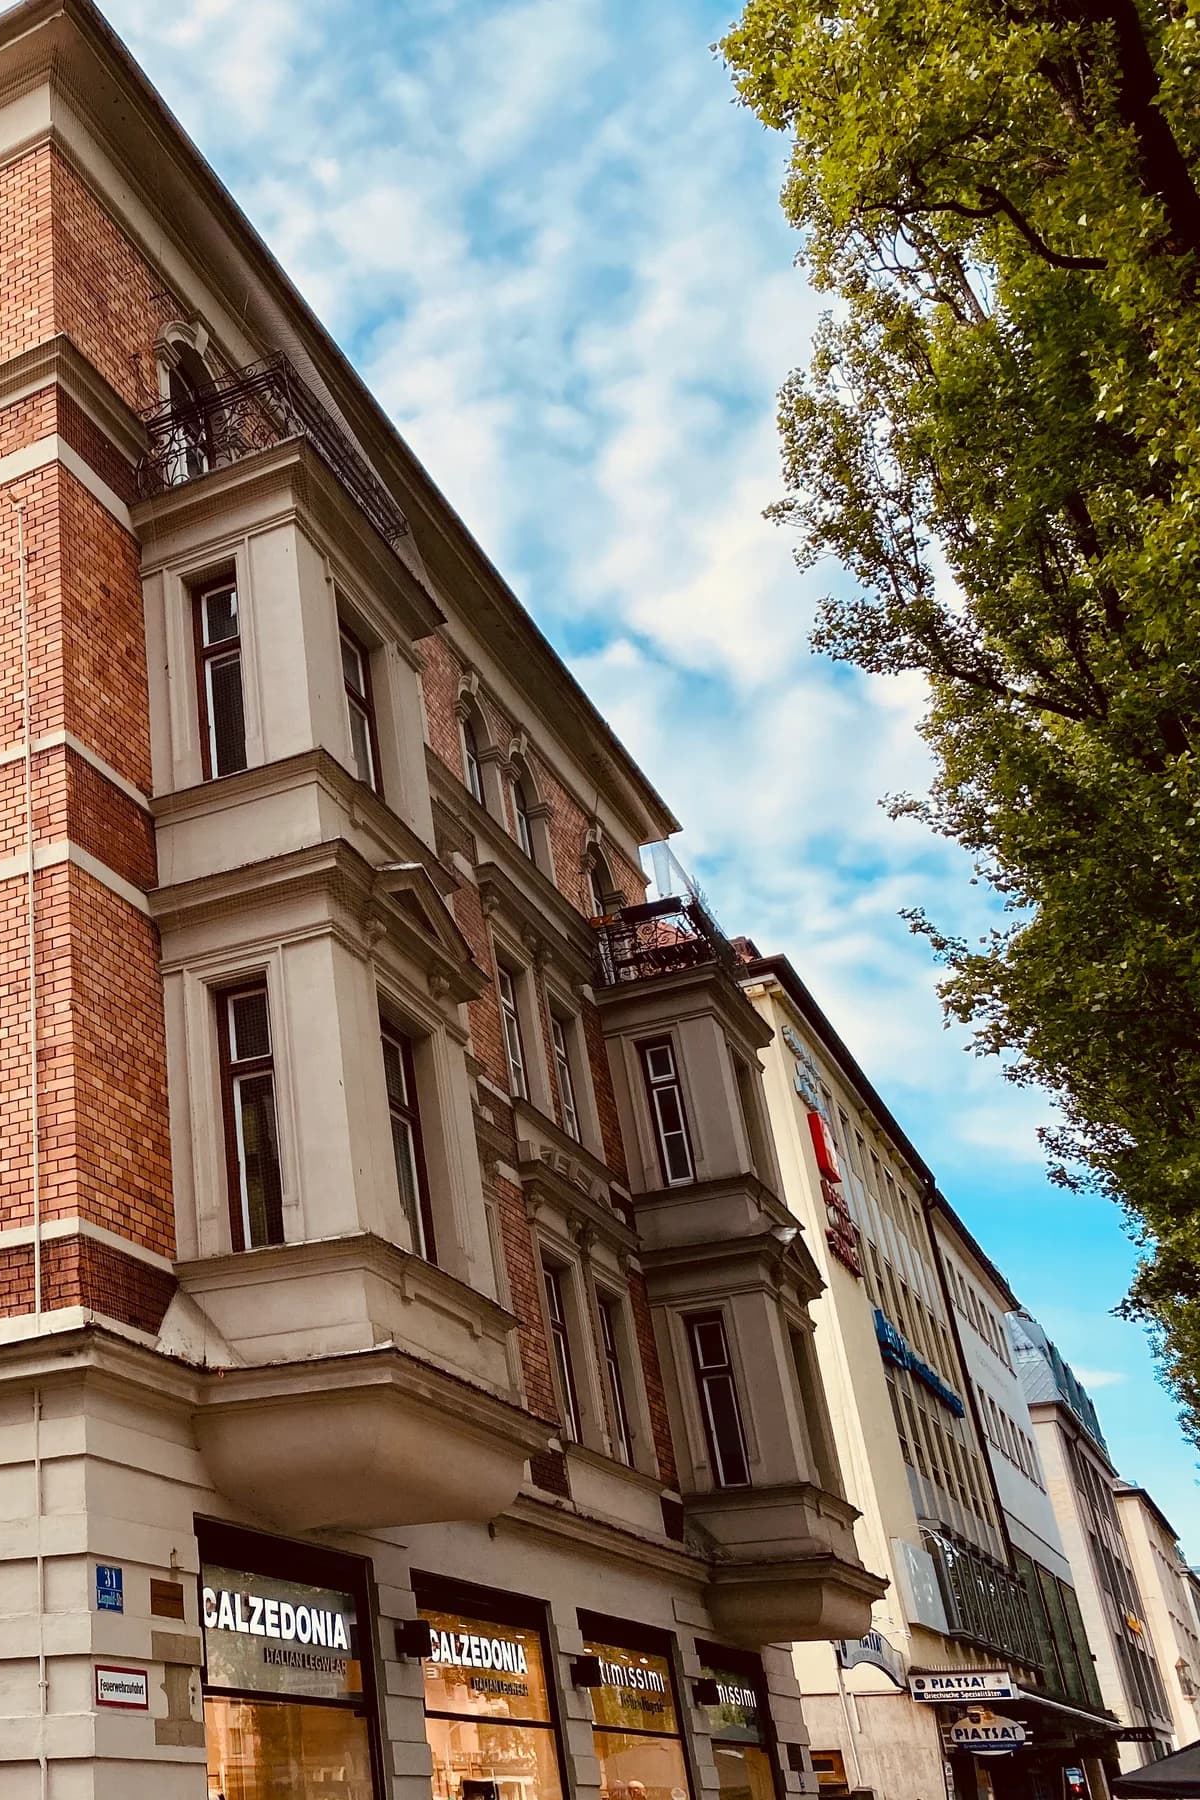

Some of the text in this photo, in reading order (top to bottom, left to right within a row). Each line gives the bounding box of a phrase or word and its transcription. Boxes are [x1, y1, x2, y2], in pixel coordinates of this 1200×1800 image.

[104, 1567, 116, 1588] 31
[202, 1586, 349, 1650] CALZEDONIA
[265, 1648, 348, 1674] ITALIAN LEGWEAR
[429, 1629, 528, 1674] CALZEDONIA
[100, 1678, 144, 1696] Feuerwehrzufahrt
